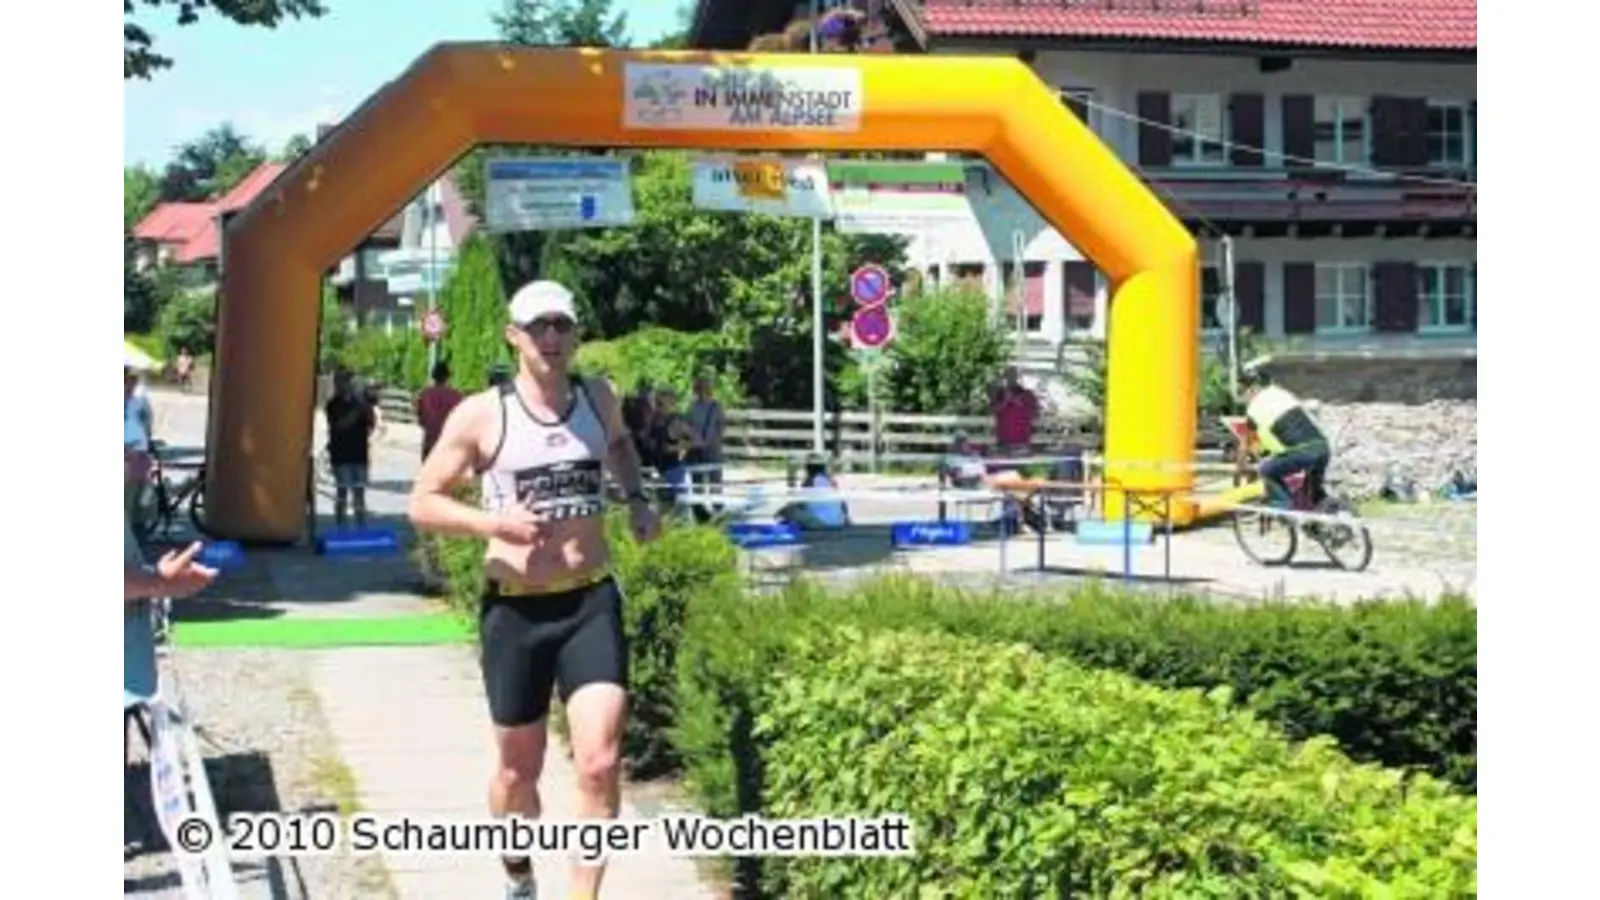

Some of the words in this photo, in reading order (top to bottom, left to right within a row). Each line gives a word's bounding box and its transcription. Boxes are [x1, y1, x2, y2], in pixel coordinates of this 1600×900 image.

[694, 88, 717, 107] IN
[726, 90, 852, 110] IMMENSTADT
[729, 109, 762, 126] AM
